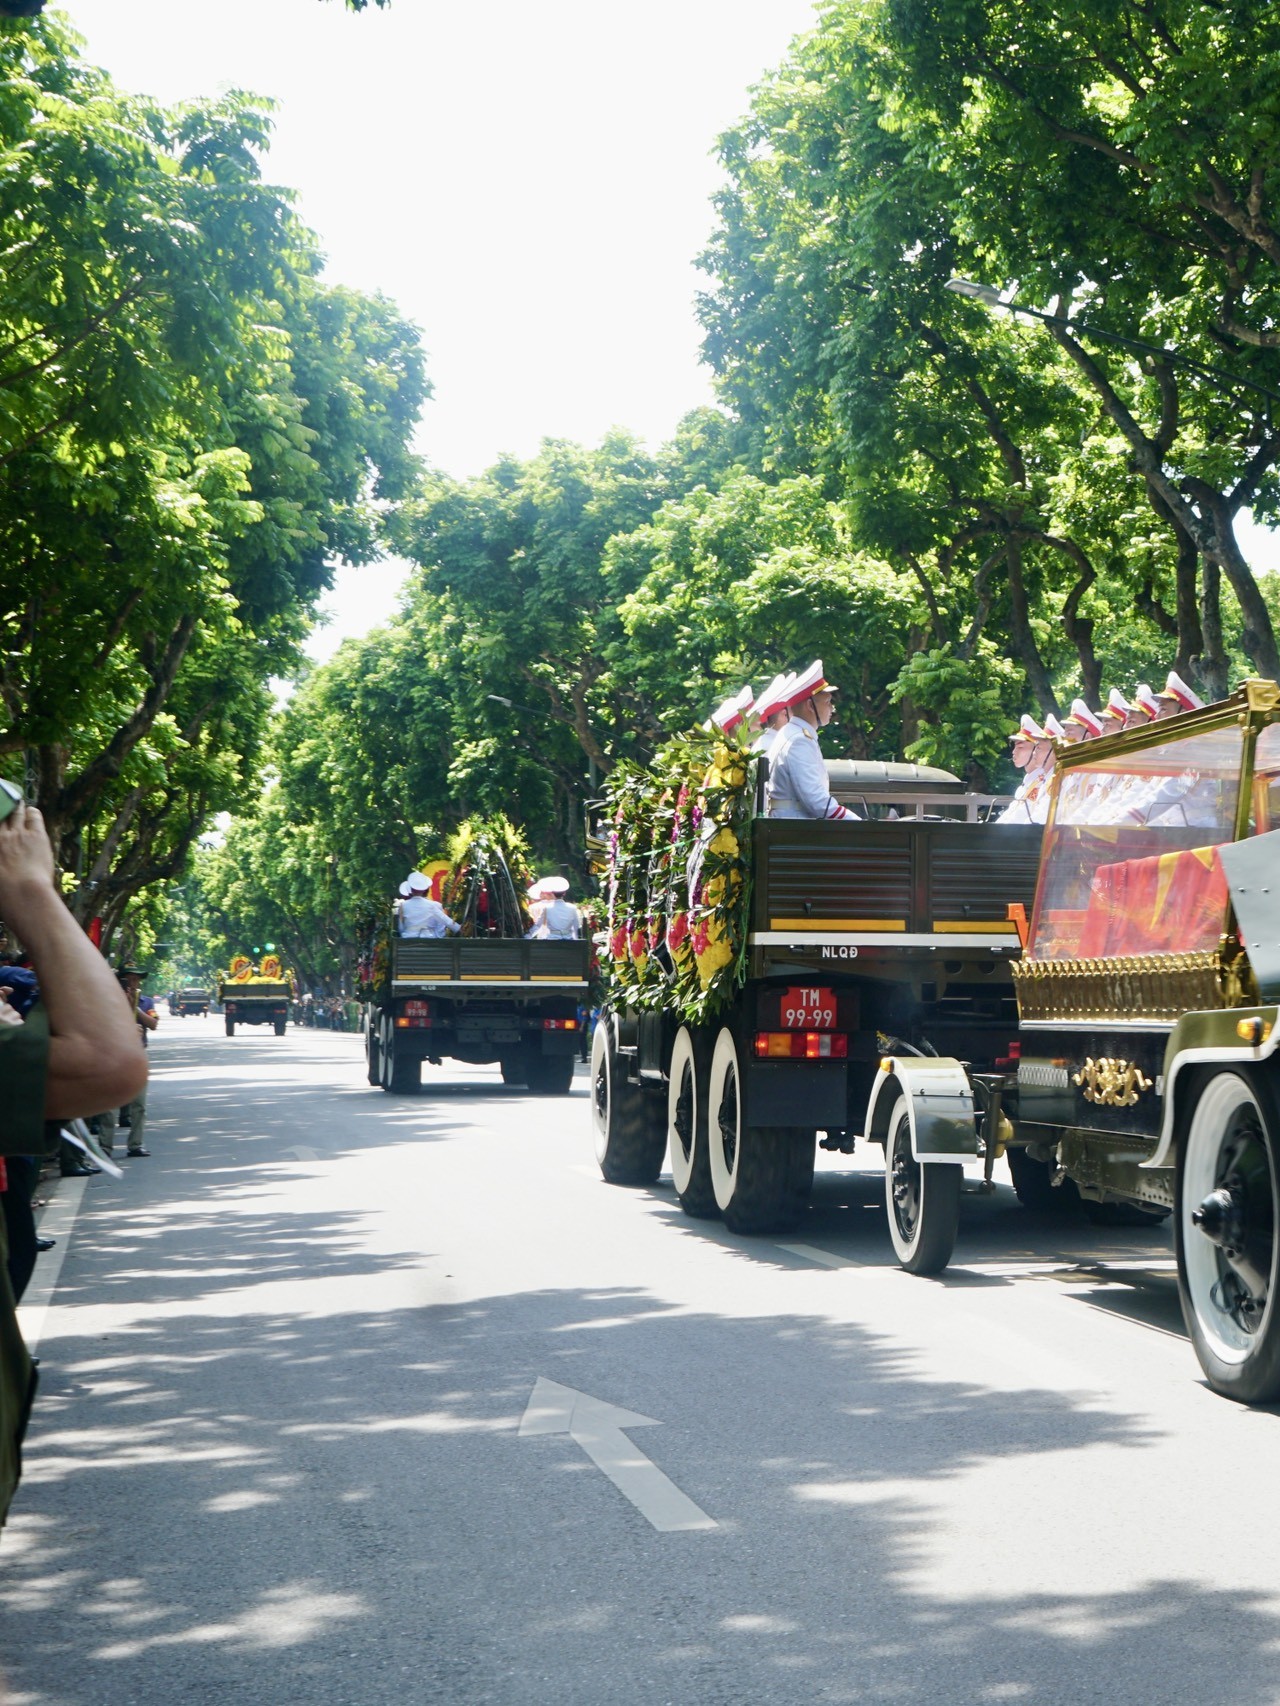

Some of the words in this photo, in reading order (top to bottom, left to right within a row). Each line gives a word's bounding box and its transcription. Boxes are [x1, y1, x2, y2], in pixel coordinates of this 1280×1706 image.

[822, 946, 858, 959] NLQĐ
[800, 989, 820, 1007] TM
[786, 1008, 833, 1027] 99-99
